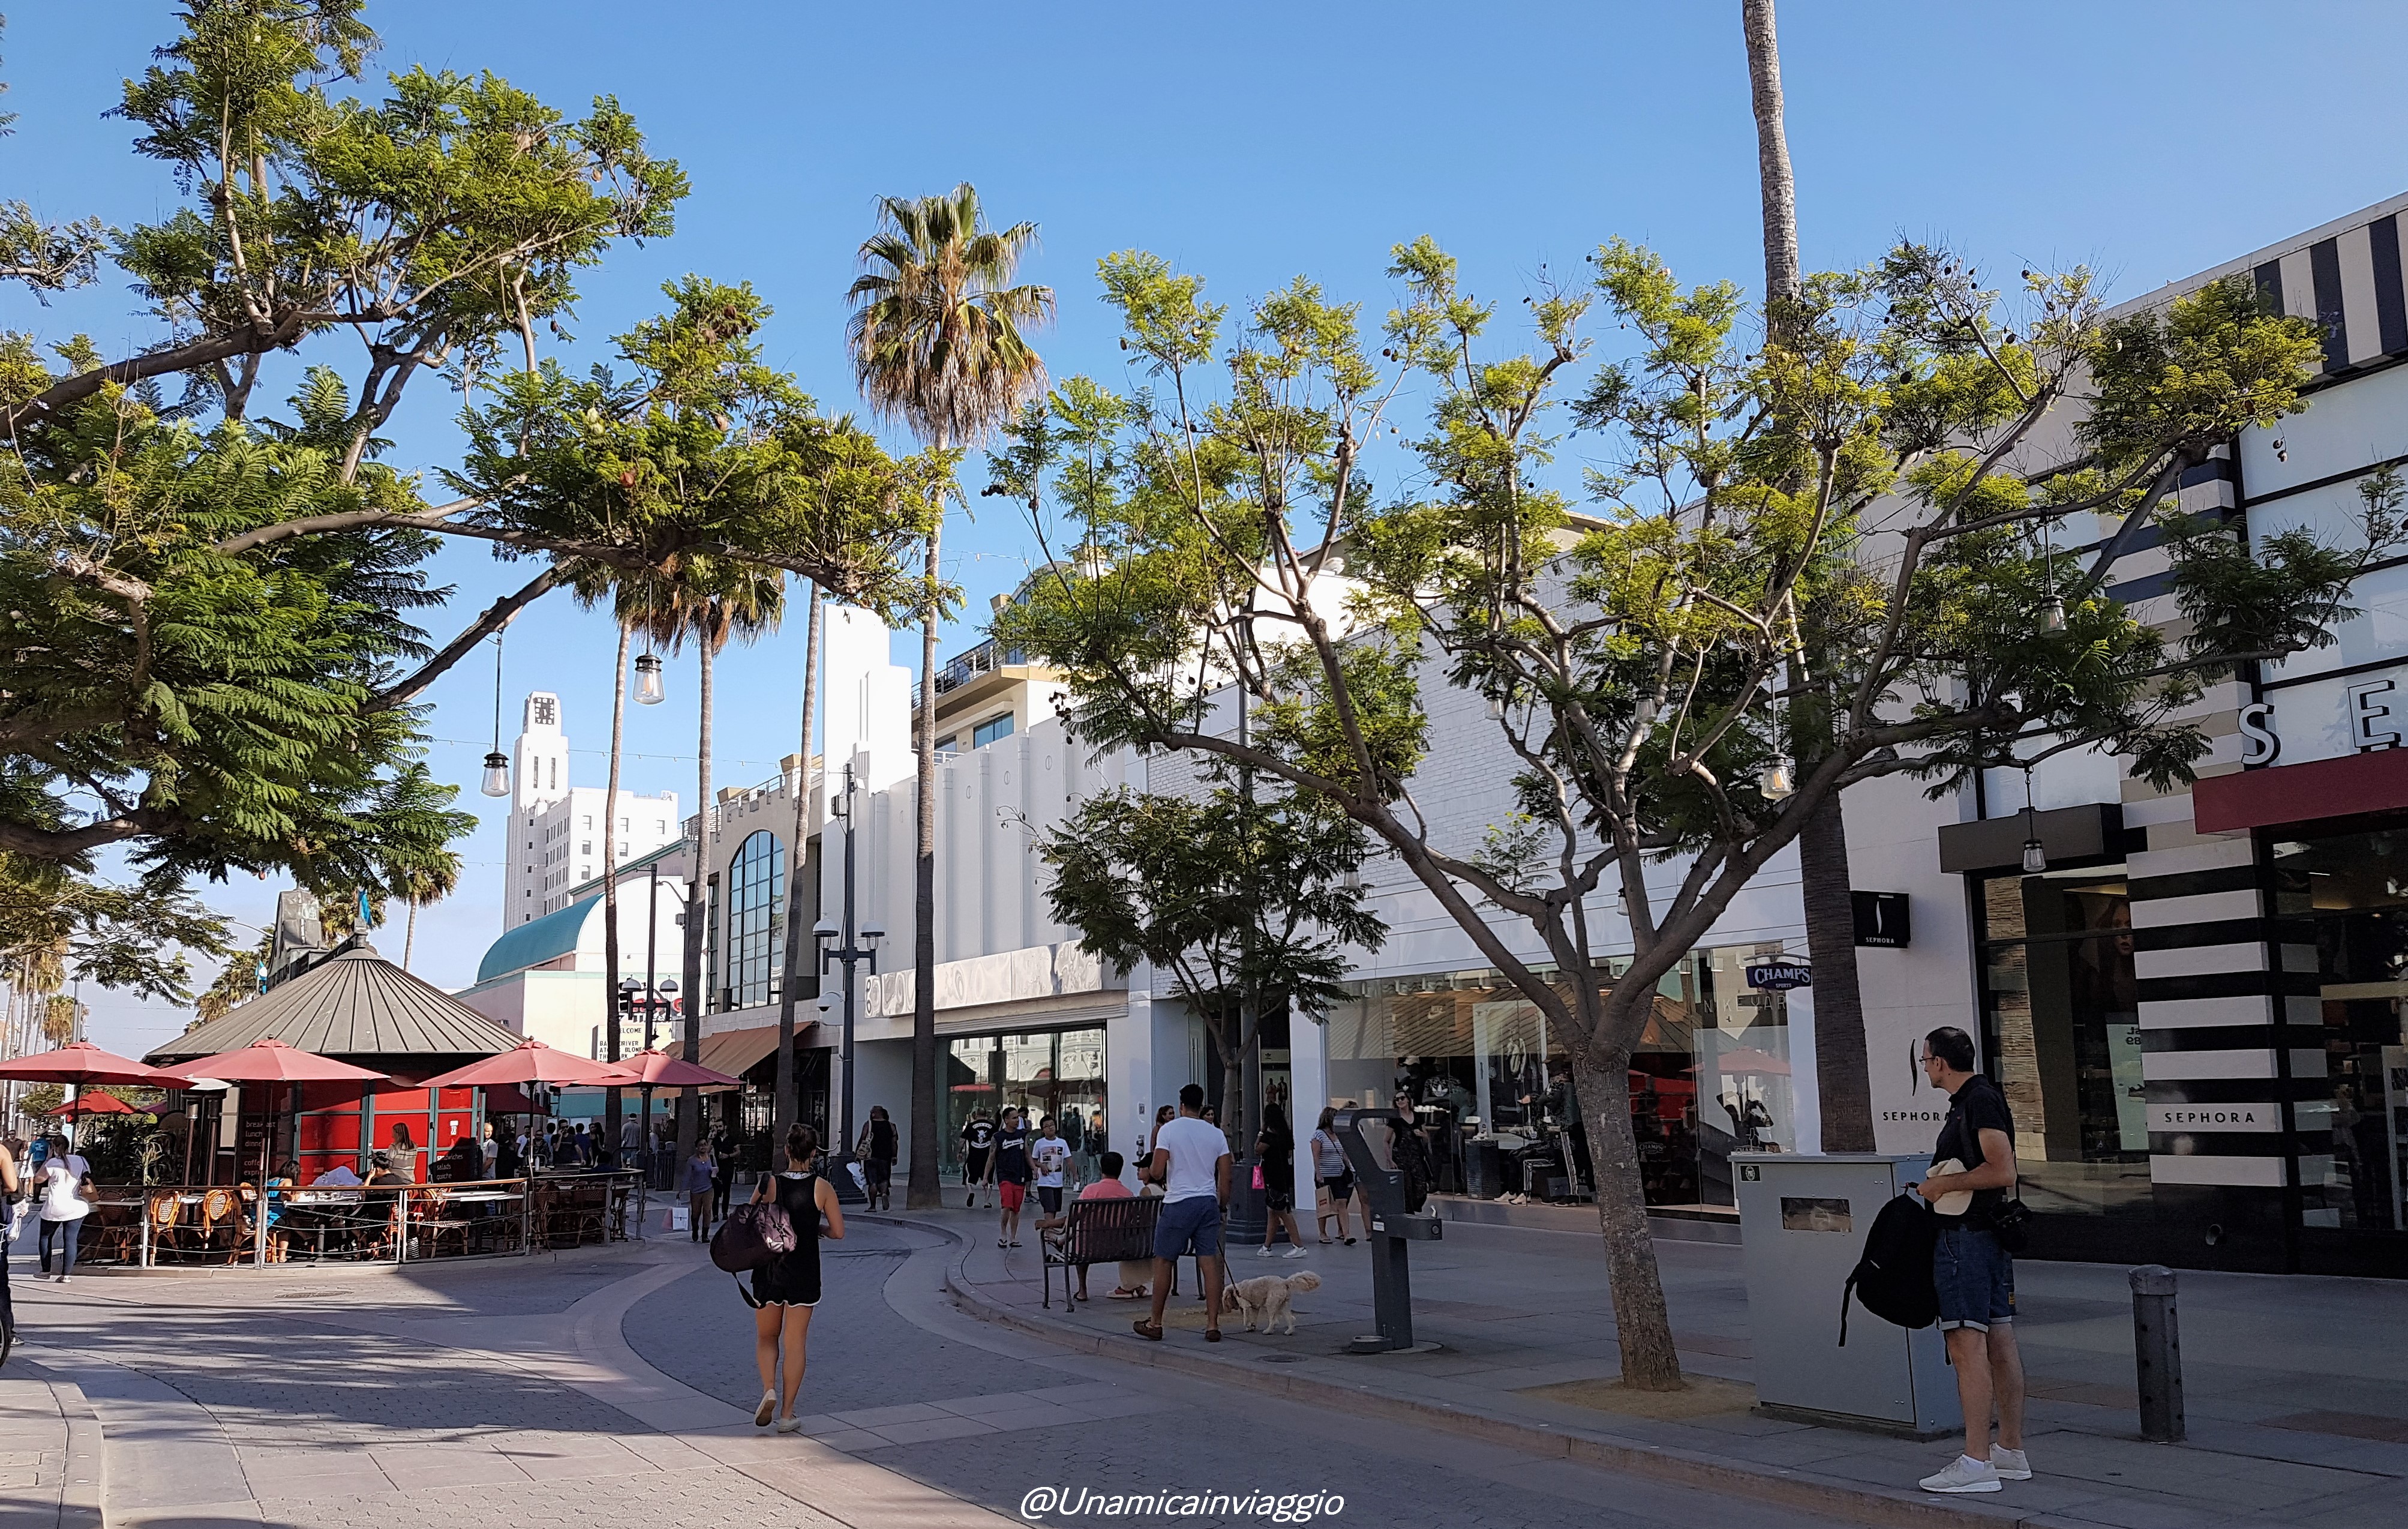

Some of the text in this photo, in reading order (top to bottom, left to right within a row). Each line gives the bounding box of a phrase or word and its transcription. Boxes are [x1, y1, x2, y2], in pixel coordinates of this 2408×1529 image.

[1754, 967, 1810, 984] CHAMPS
[1704, 996, 1787, 1013] NKE YAR
[1882, 1111, 1950, 1122] SEPHORA
[2164, 1112, 2255, 1123] SEPHORA
[1640, 1143, 1664, 1152] CHAMPS
